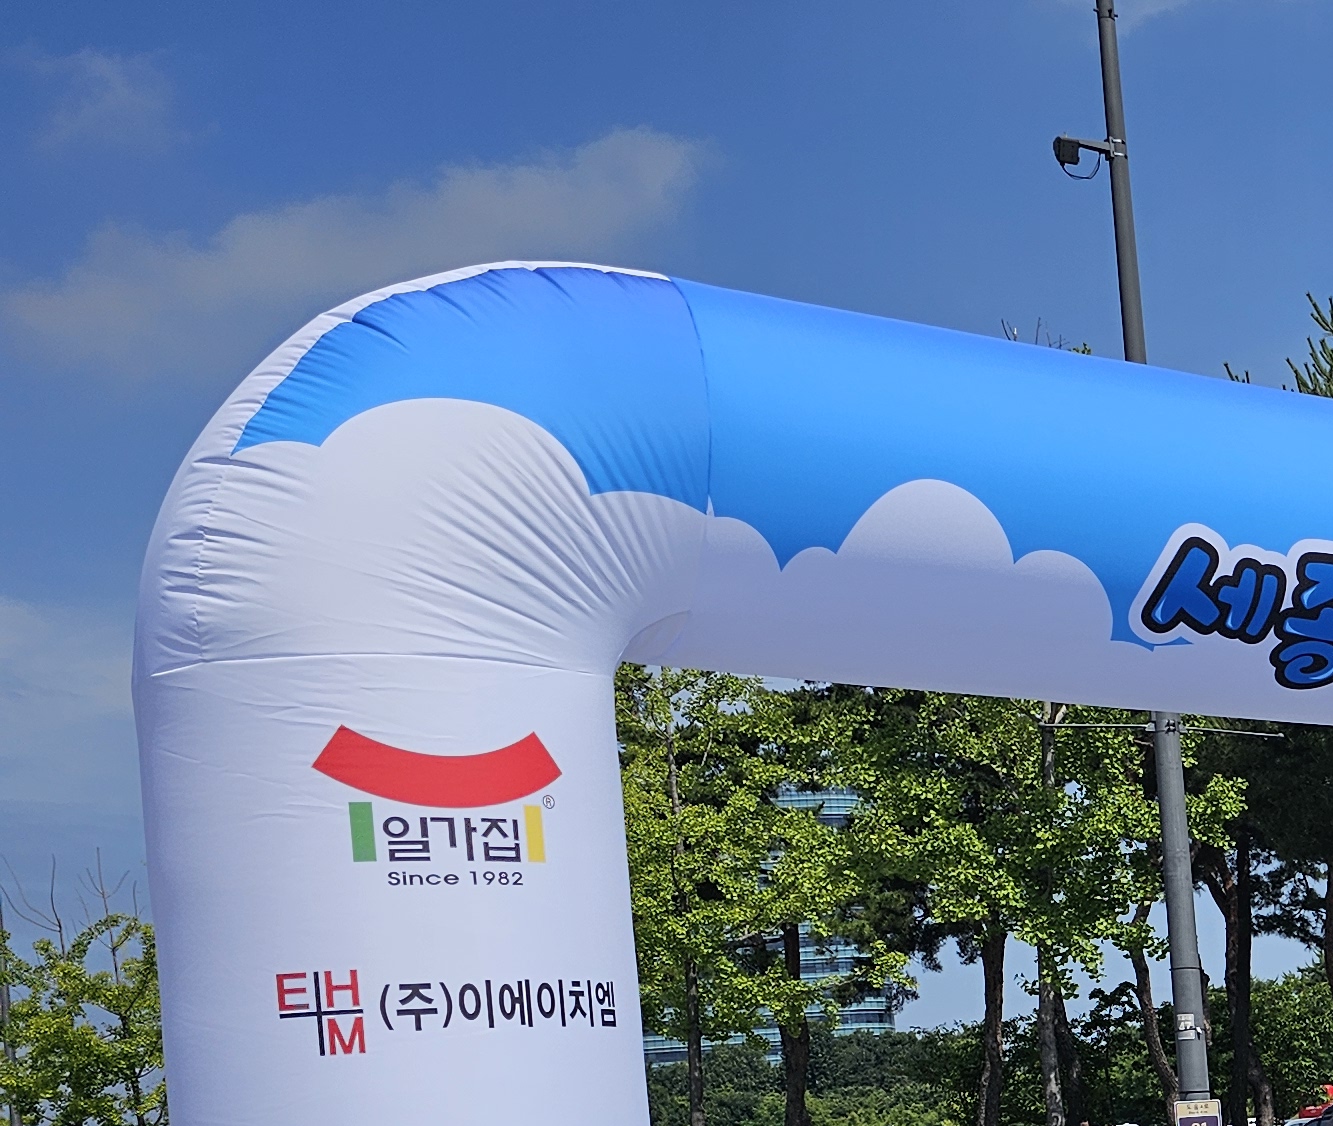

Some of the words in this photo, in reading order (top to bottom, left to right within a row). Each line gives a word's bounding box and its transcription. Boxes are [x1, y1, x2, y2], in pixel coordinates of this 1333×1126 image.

[382, 815, 523, 863] 일가집
[387, 870, 460, 888] Since
[469, 871, 525, 887] 1982
[379, 979, 618, 1031] (주)이에이치엠
